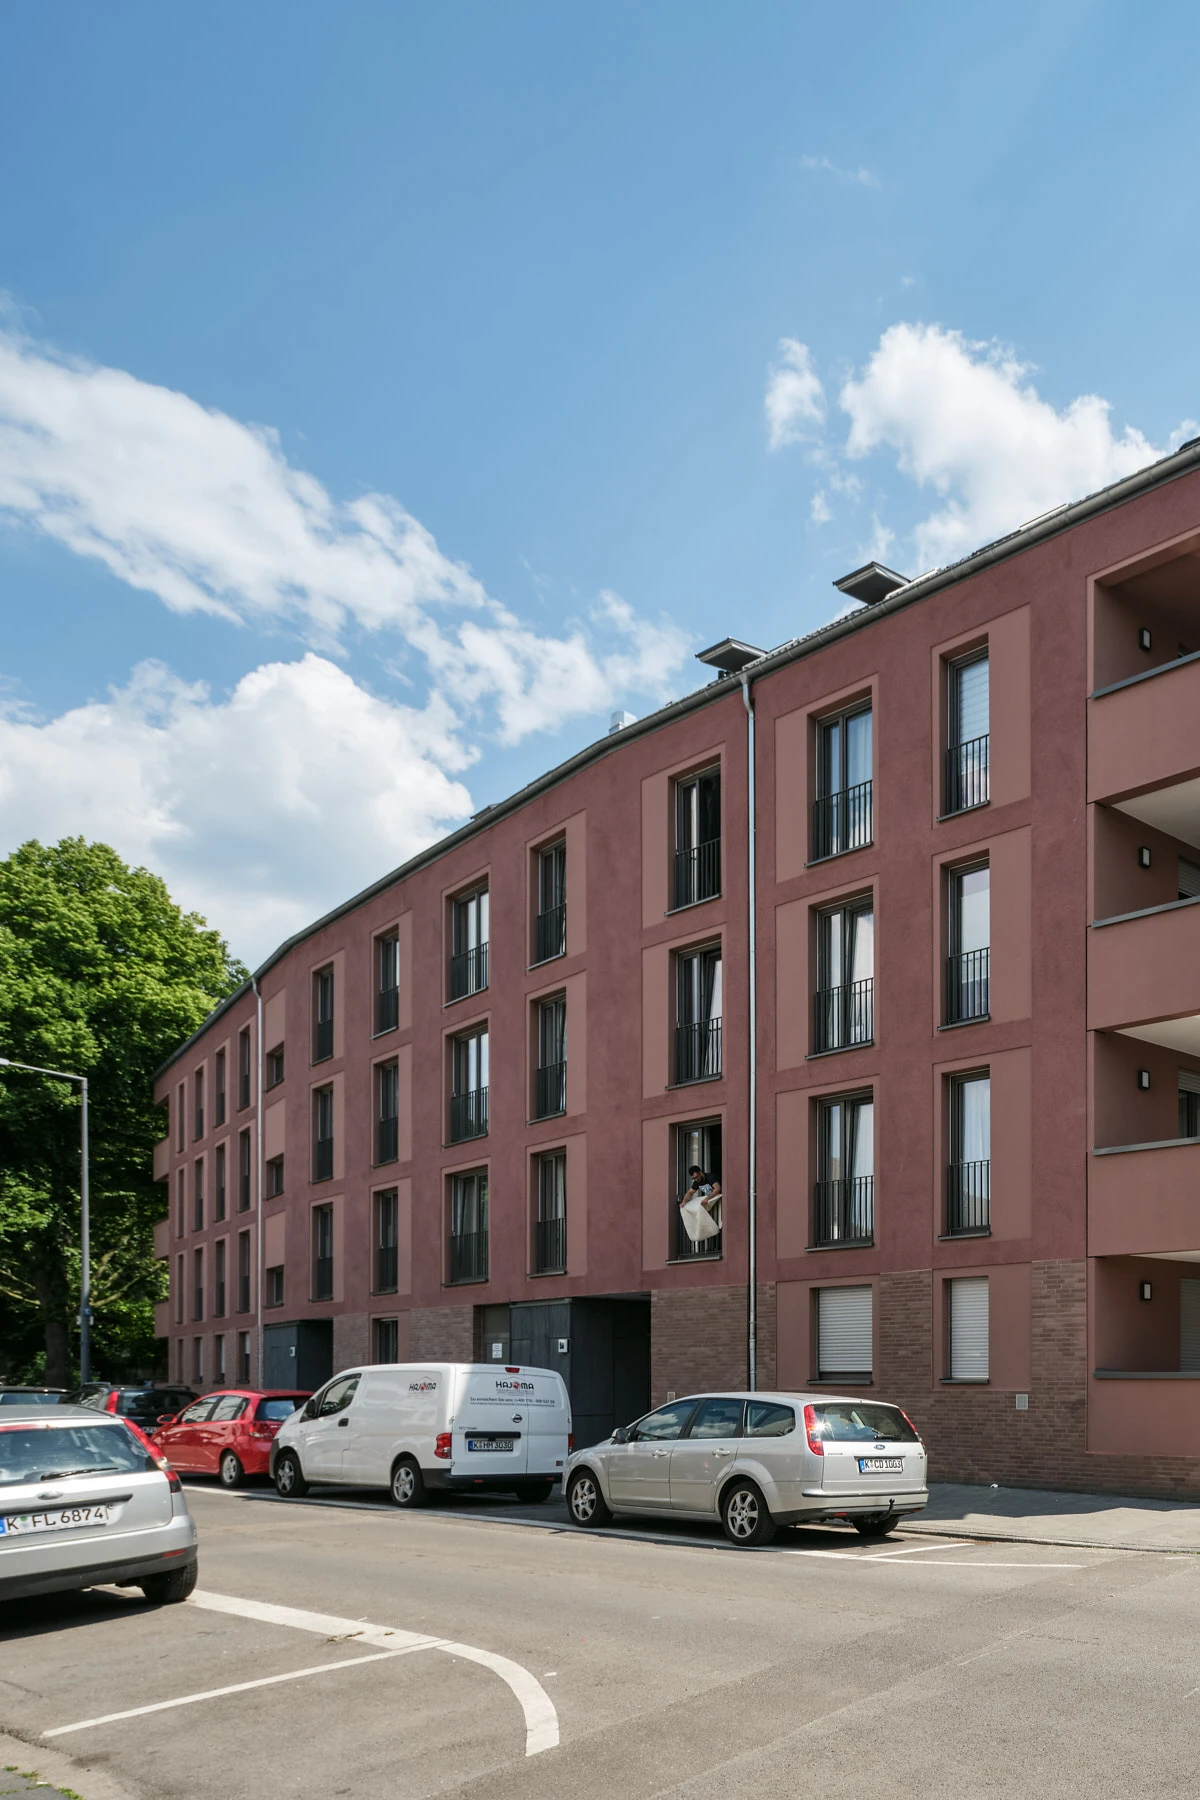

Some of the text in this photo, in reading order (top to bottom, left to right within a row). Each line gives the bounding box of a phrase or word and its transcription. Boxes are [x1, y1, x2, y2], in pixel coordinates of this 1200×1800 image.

[496, 1381, 534, 1390] HAJOMA
[483, 1442, 494, 1450] HM
[494, 1442, 513, 1450] 3030
[865, 1460, 902, 1468] K CD 1003
[6, 1508, 104, 1531] K FL 6874
